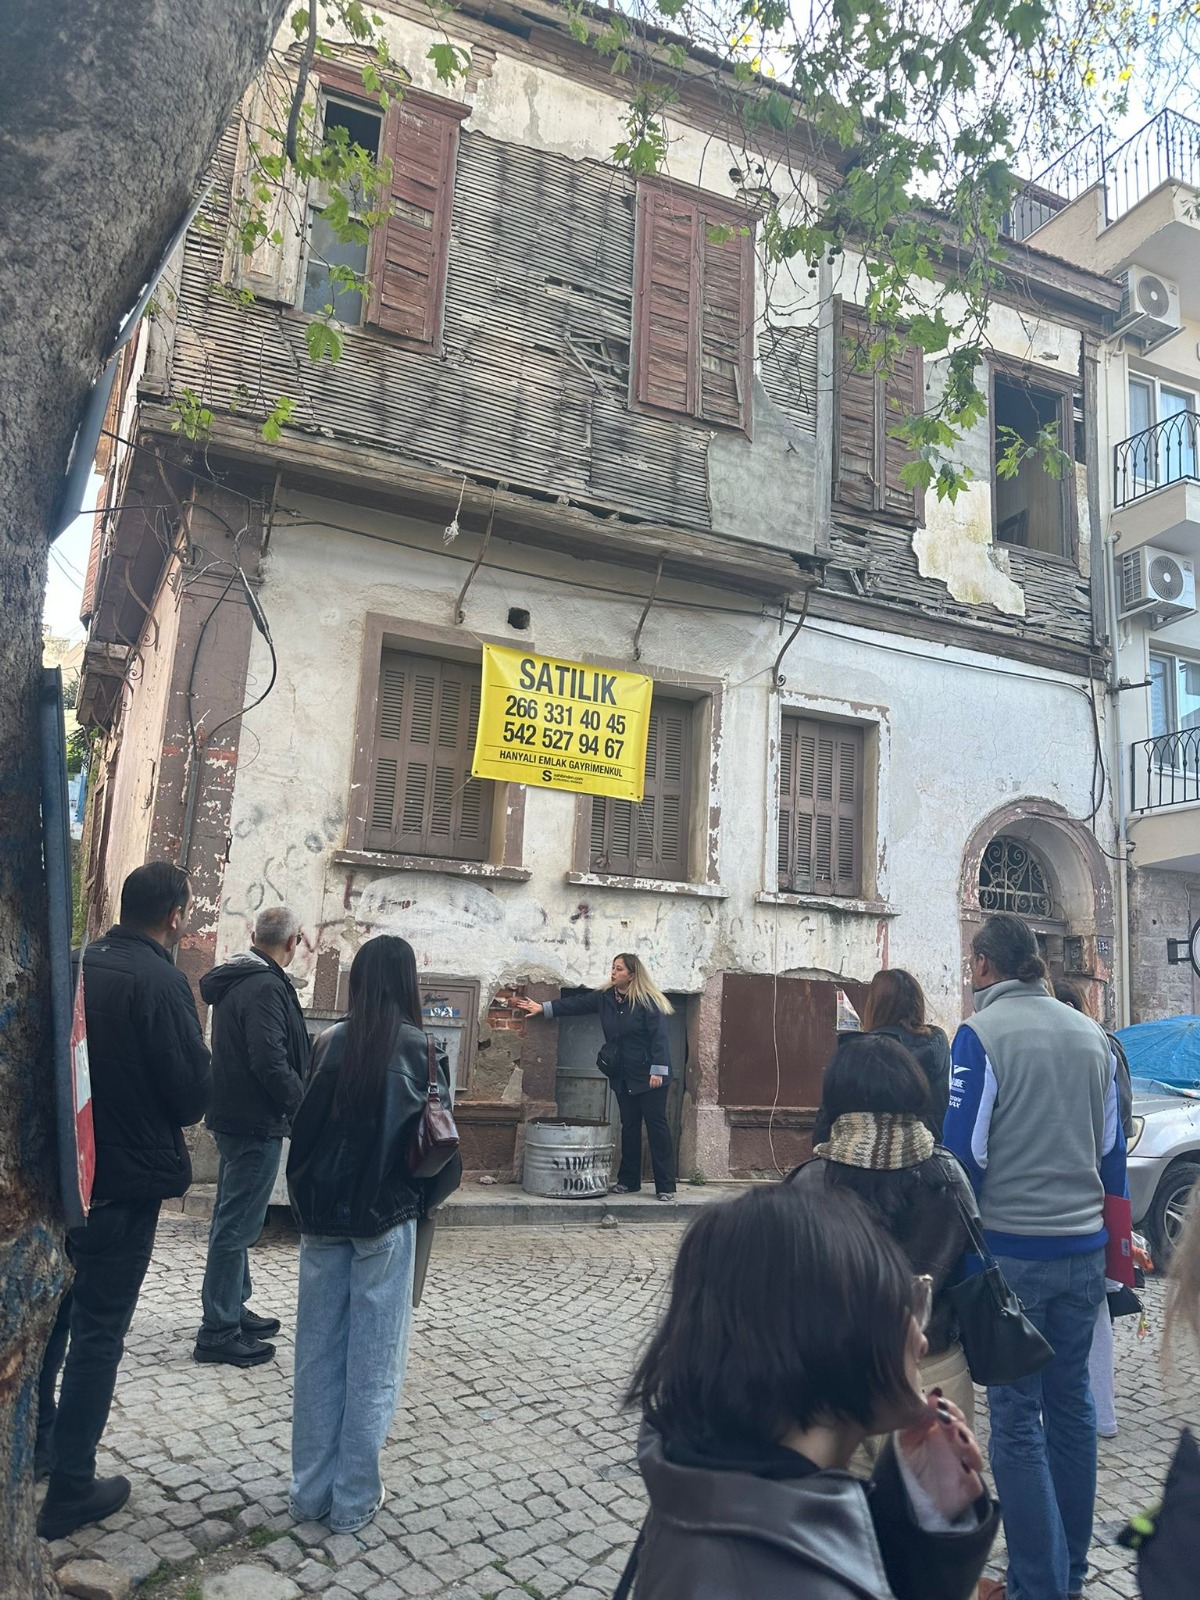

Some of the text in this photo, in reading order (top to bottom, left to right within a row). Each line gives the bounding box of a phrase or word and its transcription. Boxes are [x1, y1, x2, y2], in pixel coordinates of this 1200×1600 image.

[519, 658, 618, 706] SATILIK
[505, 695, 626, 735] 266 331 40 45
[499, 750, 537, 764] HANYALI
[538, 757, 567, 769] EMLAK
[503, 721, 625, 760] 542 527 94 67
